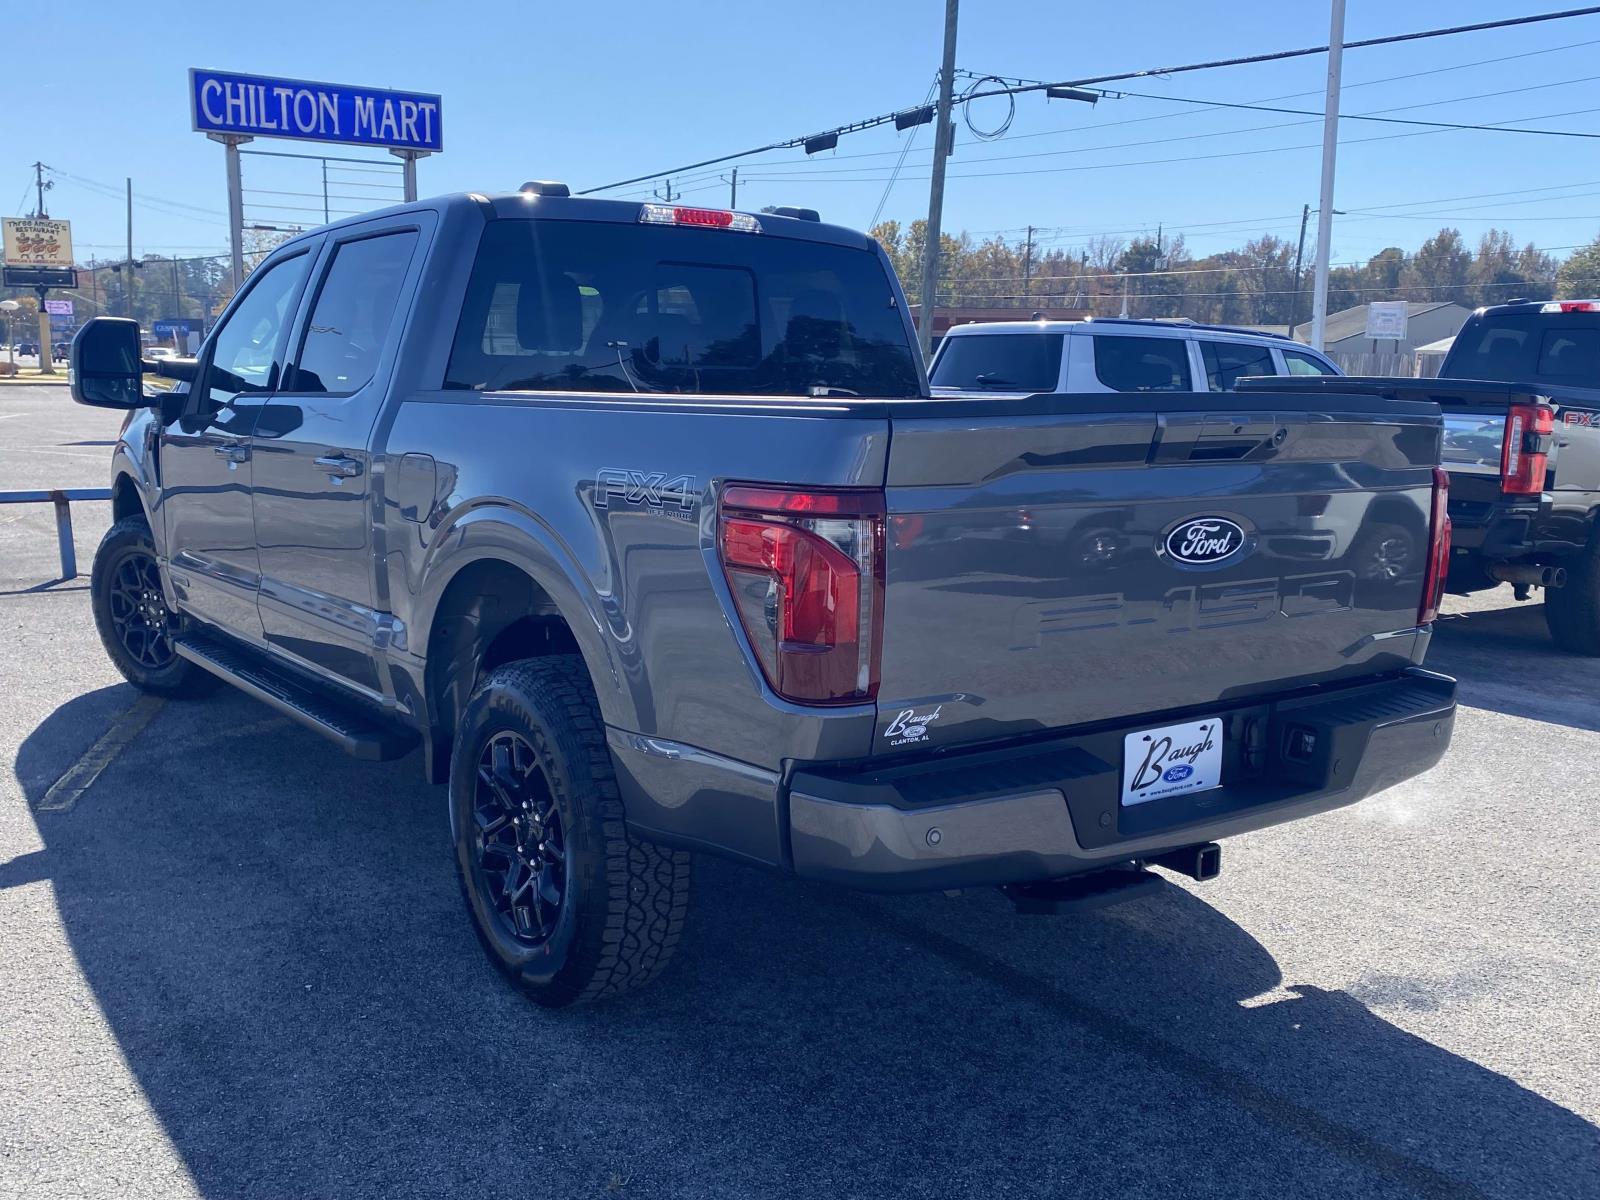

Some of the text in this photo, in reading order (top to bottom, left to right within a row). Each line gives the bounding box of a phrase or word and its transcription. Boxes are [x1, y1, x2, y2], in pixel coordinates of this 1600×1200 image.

[200, 79, 437, 143] CHILTON MART
[594, 467, 697, 511] FX4
[1181, 525, 1232, 556] Ford
[884, 705, 942, 737] Baugh
[891, 737, 920, 745] CLANTON,
[1130, 724, 1215, 792] Baugh
[1168, 768, 1188, 780] Ford
